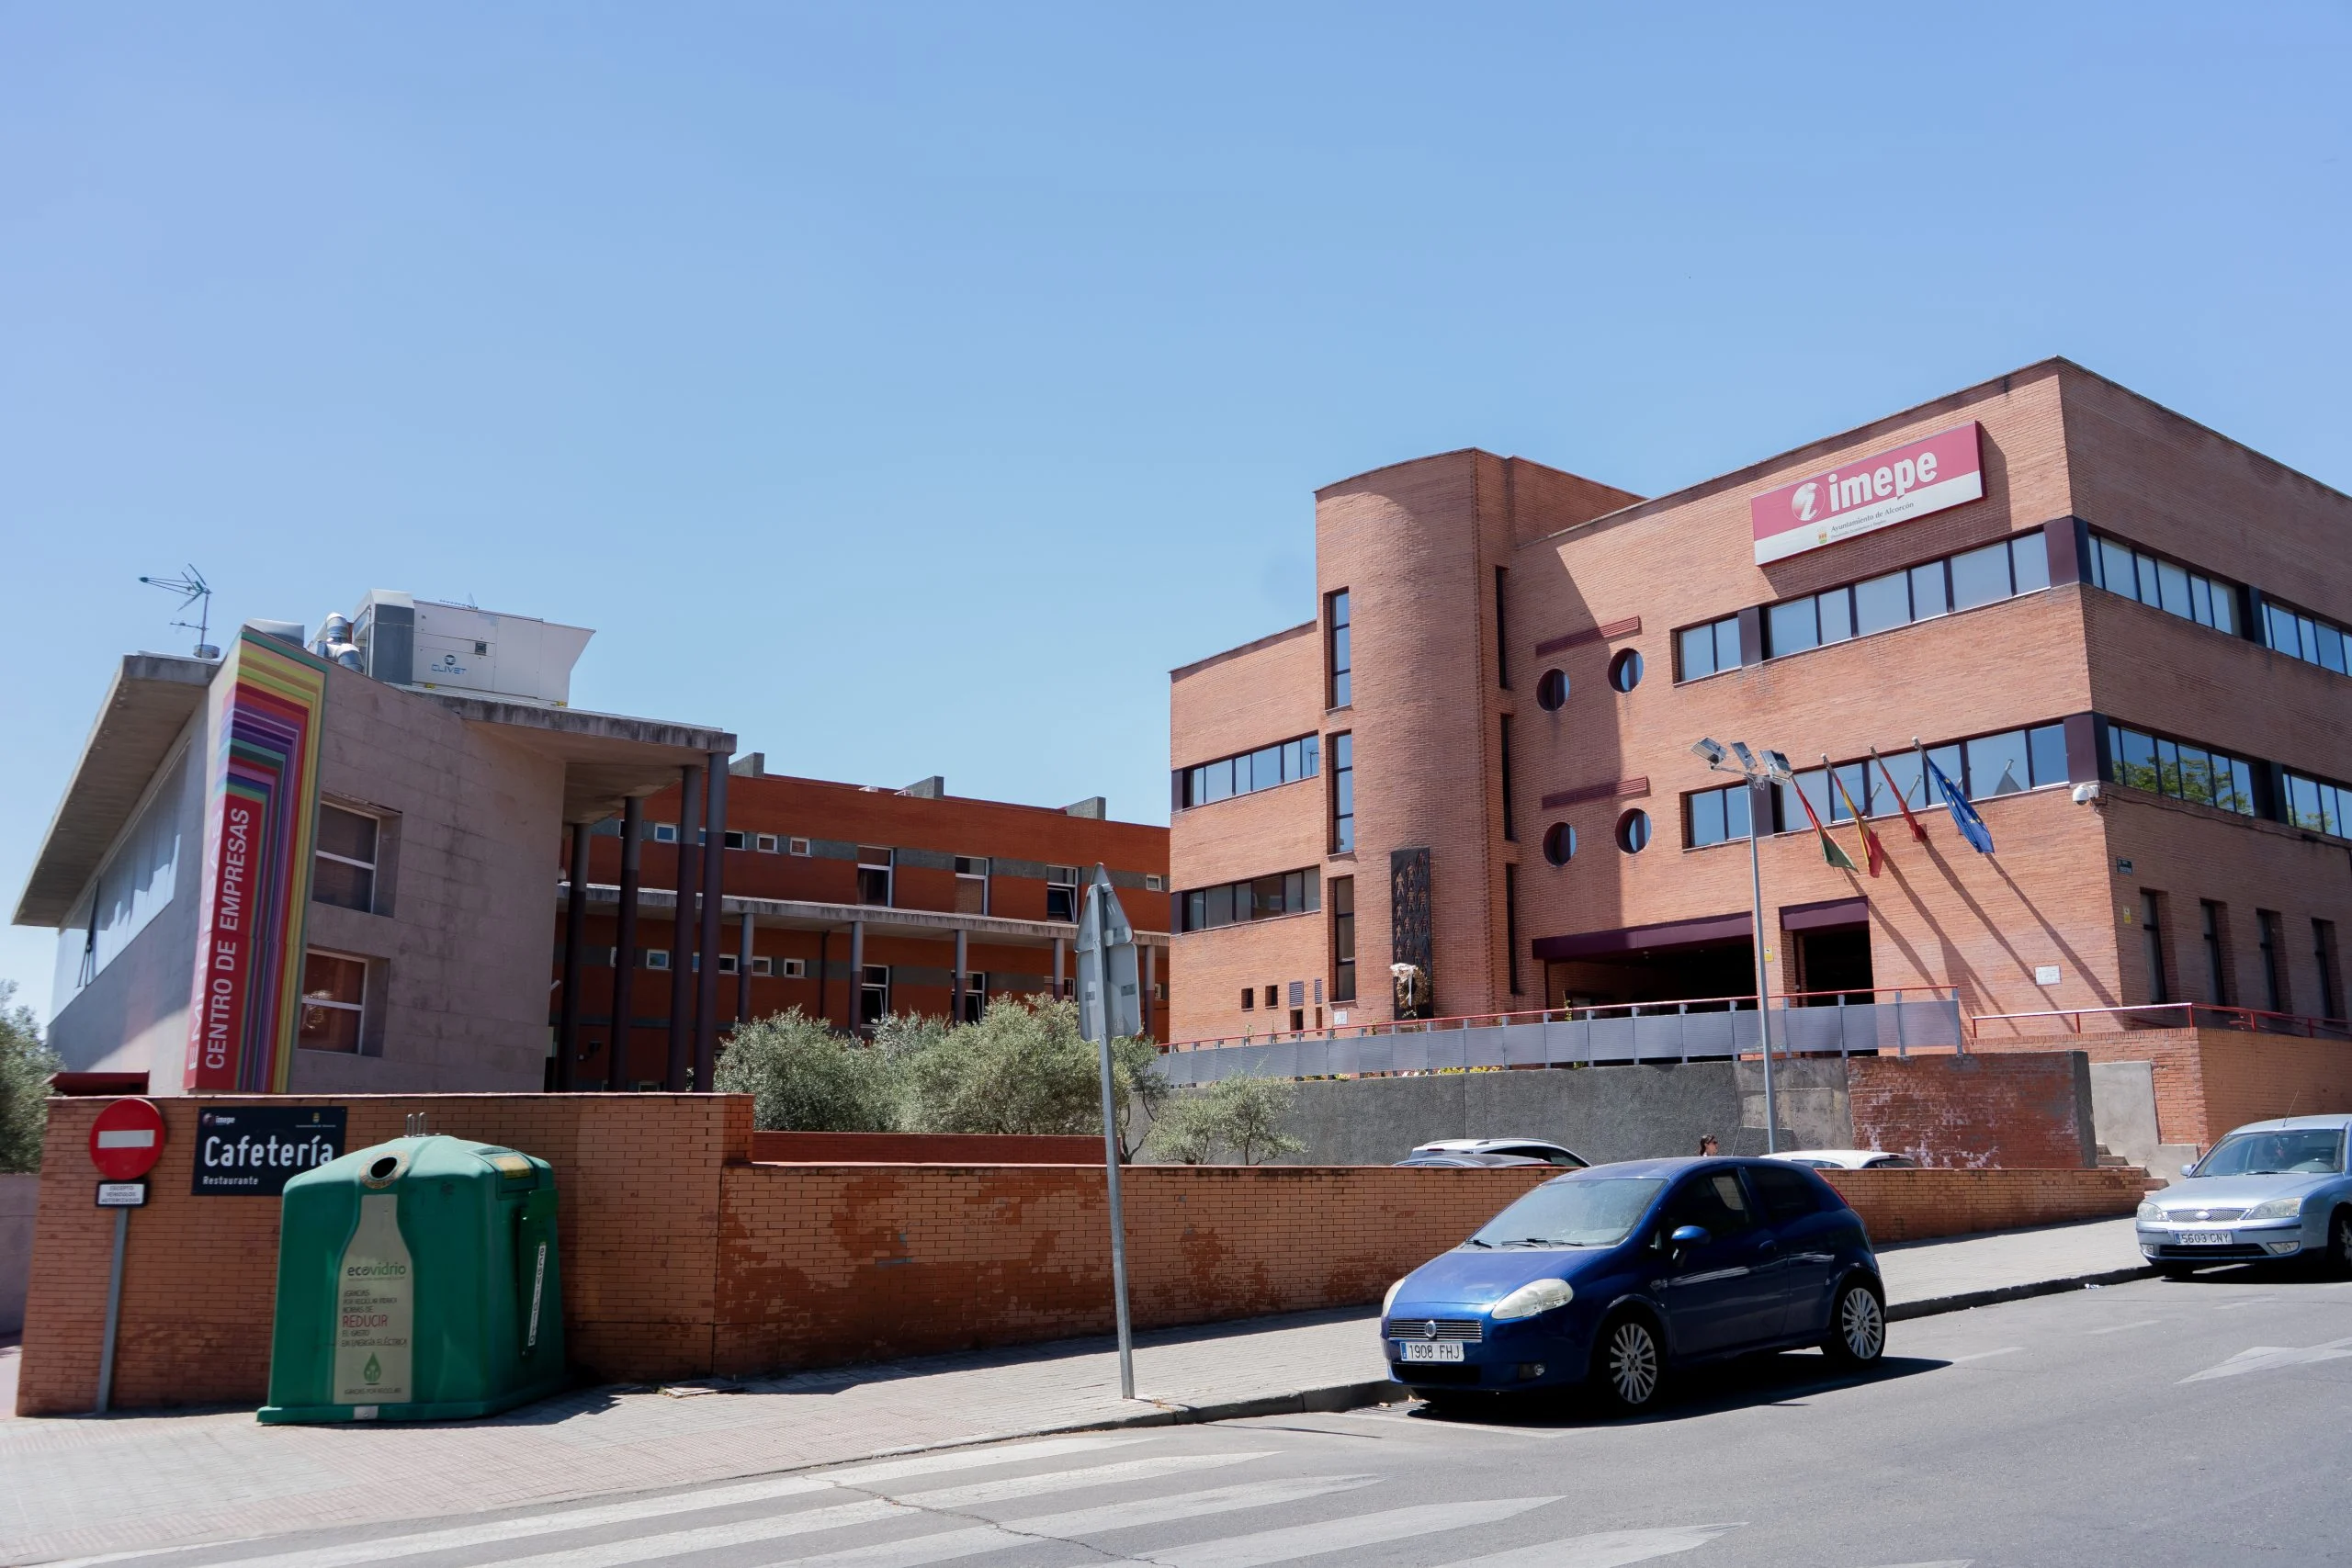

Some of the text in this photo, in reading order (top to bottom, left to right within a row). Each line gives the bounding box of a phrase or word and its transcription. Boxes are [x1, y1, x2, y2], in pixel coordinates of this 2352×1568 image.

[1828, 452, 1938, 512] imepe
[1830, 514, 1874, 532] Ayuntamiento
[1884, 502, 1915, 514] Alcorcón
[432, 664, 467, 674] CLIVET
[206, 807, 250, 1069] CENTRO DE EMPRESAS
[204, 1135, 334, 1167] Cafetería
[202, 1176, 259, 1185] Restaurante
[2181, 1234, 2228, 1243] 5603 CNY
[347, 1262, 406, 1276] ecovidrio
[343, 1314, 388, 1328] REDUCIR
[1409, 1345, 1460, 1359] 1908 FHJ
